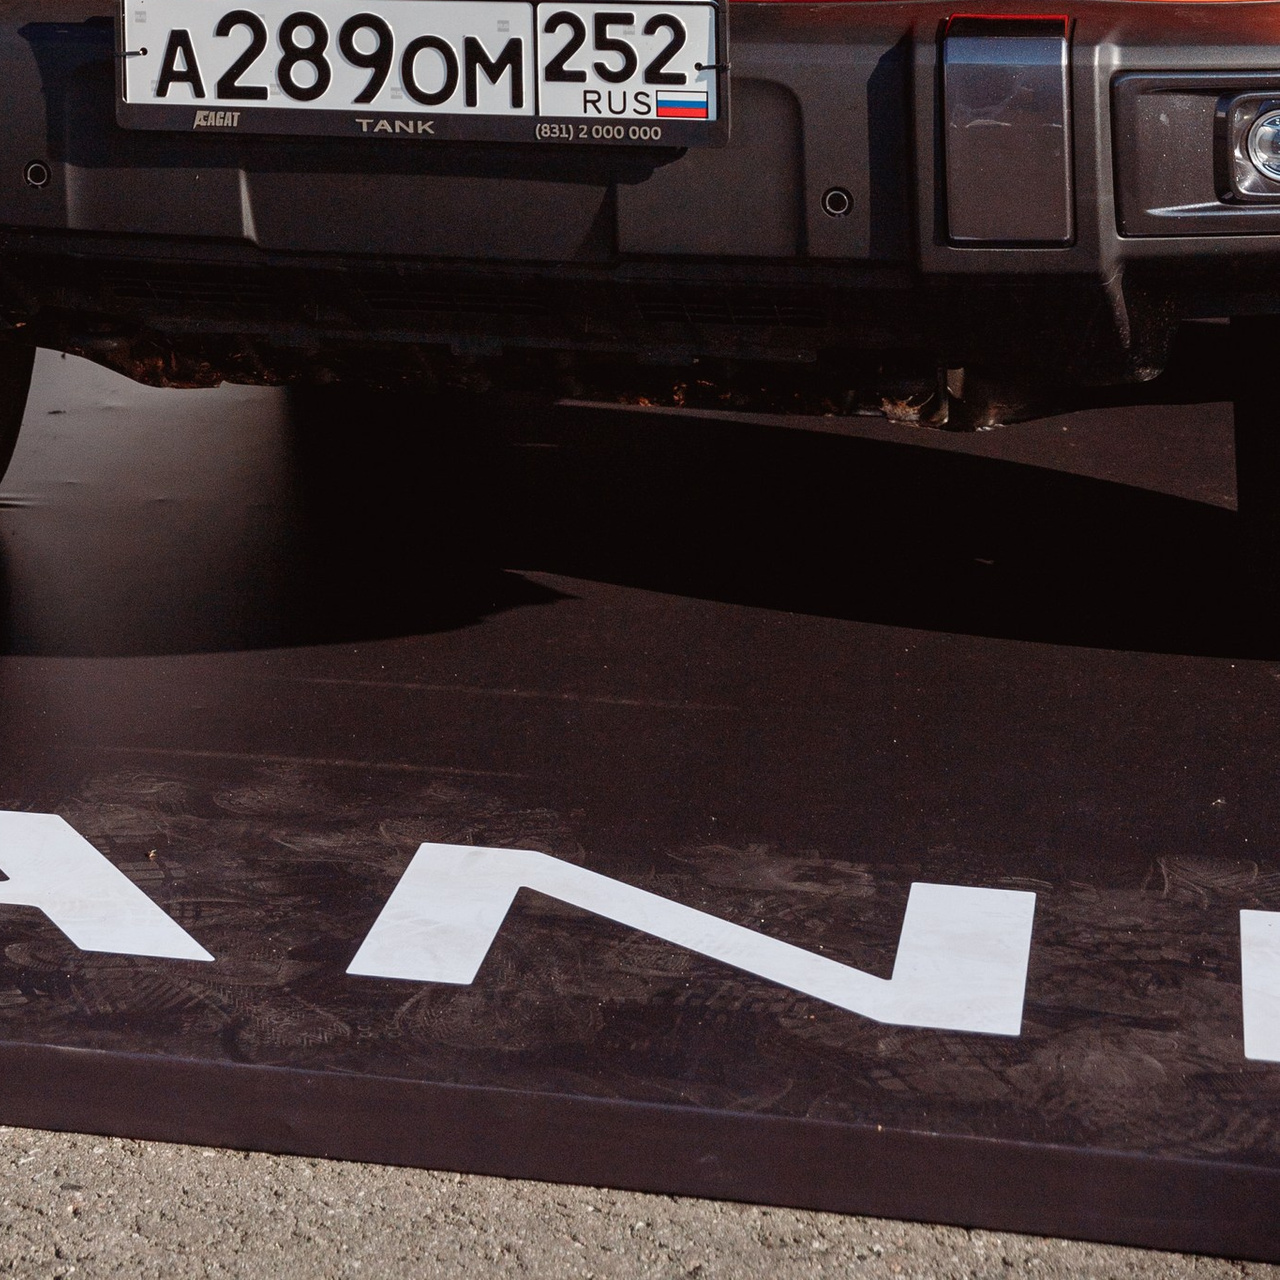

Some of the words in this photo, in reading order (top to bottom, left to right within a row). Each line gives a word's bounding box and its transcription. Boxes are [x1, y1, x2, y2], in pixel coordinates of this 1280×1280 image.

[154, 9, 525, 109] A289OM
[544, 10, 688, 85] 252
[583, 89, 652, 116] RUS
[355, 118, 436, 135] TANK
[534, 123, 574, 140] (831)
[578, 125, 588, 139] 2
[591, 125, 625, 139] 000
[628, 126, 662, 141] 000
